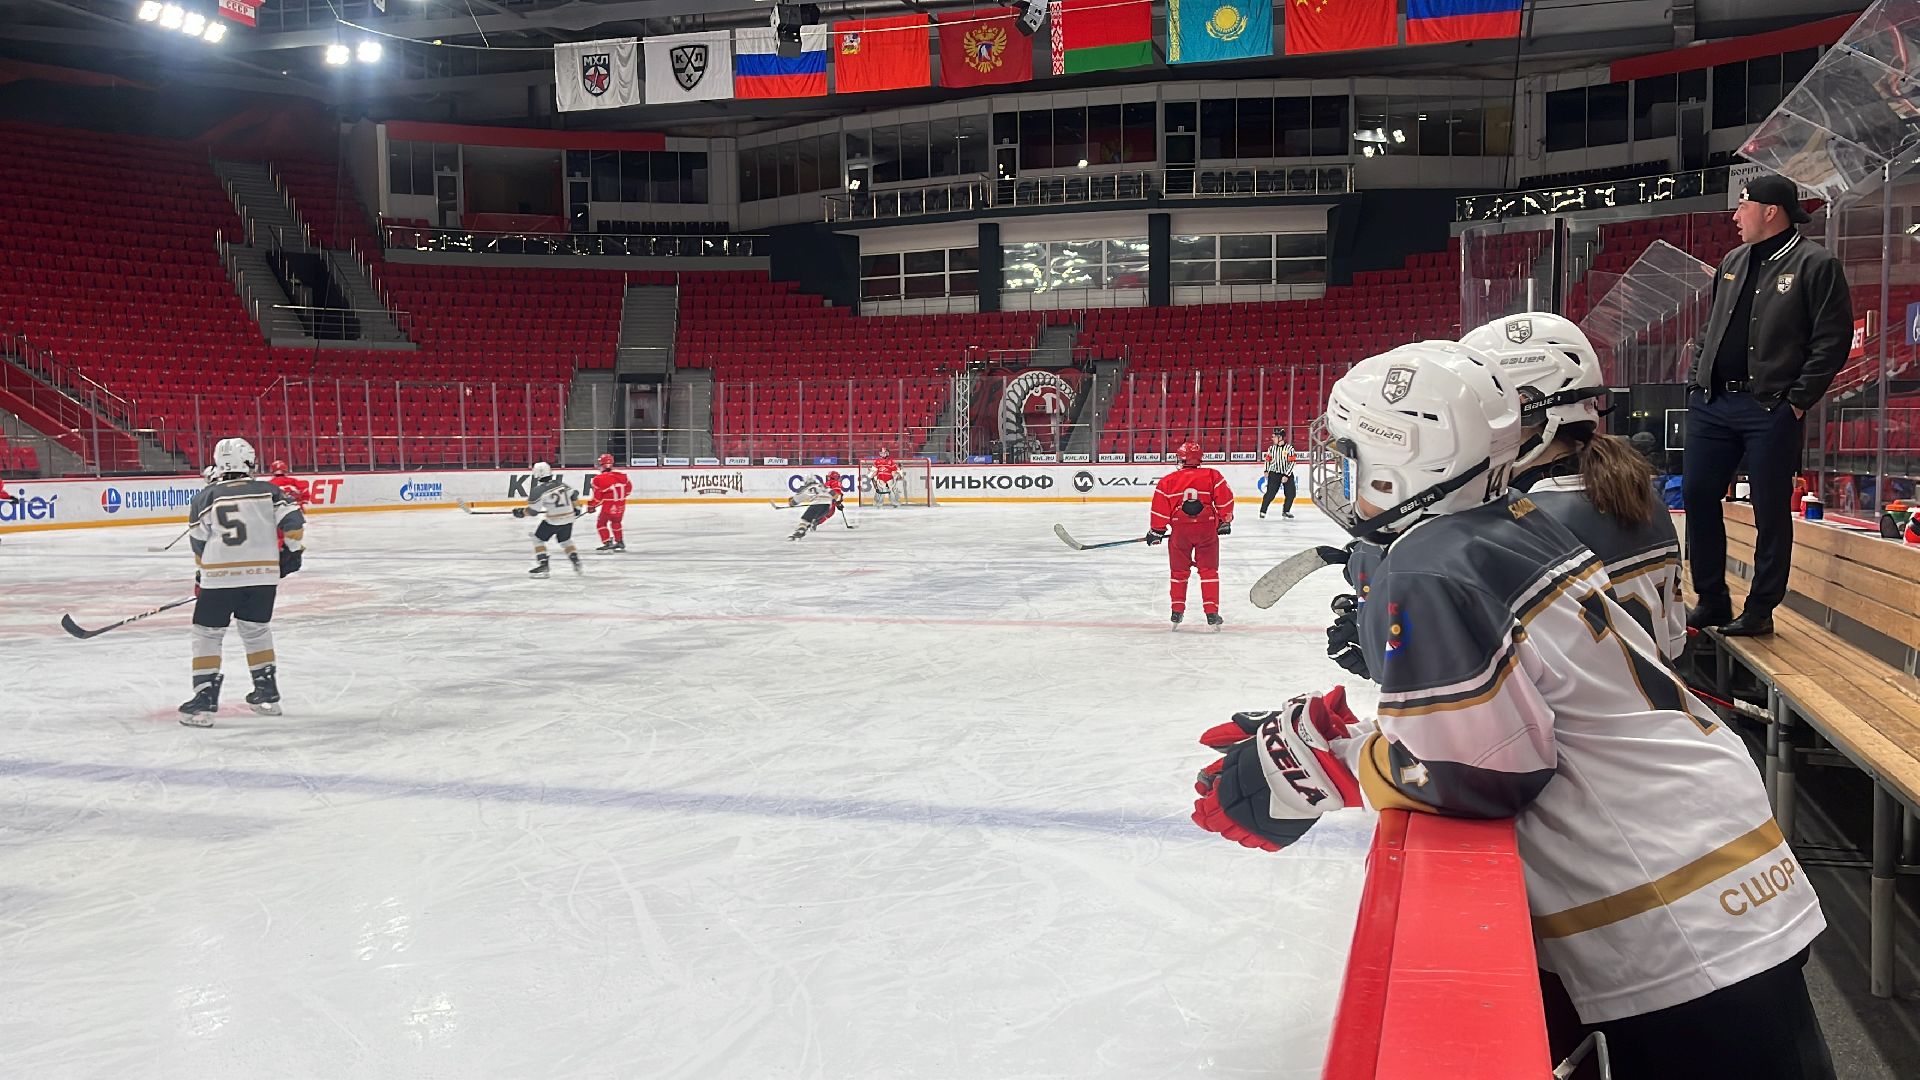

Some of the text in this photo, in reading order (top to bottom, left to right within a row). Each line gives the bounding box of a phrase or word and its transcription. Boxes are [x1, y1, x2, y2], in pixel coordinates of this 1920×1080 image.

[583, 55, 609, 66] МХЛ
[1500, 355, 1546, 365] BAUER
[1359, 422, 1403, 442] BAUER
[413, 483, 442, 491] ГАЗПРОМ
[681, 471, 744, 494] ТУЛЬСКИЙ
[125, 486, 200, 511] севернефтег
[215, 503, 247, 547] 5
[1719, 857, 1796, 916] СШОР
